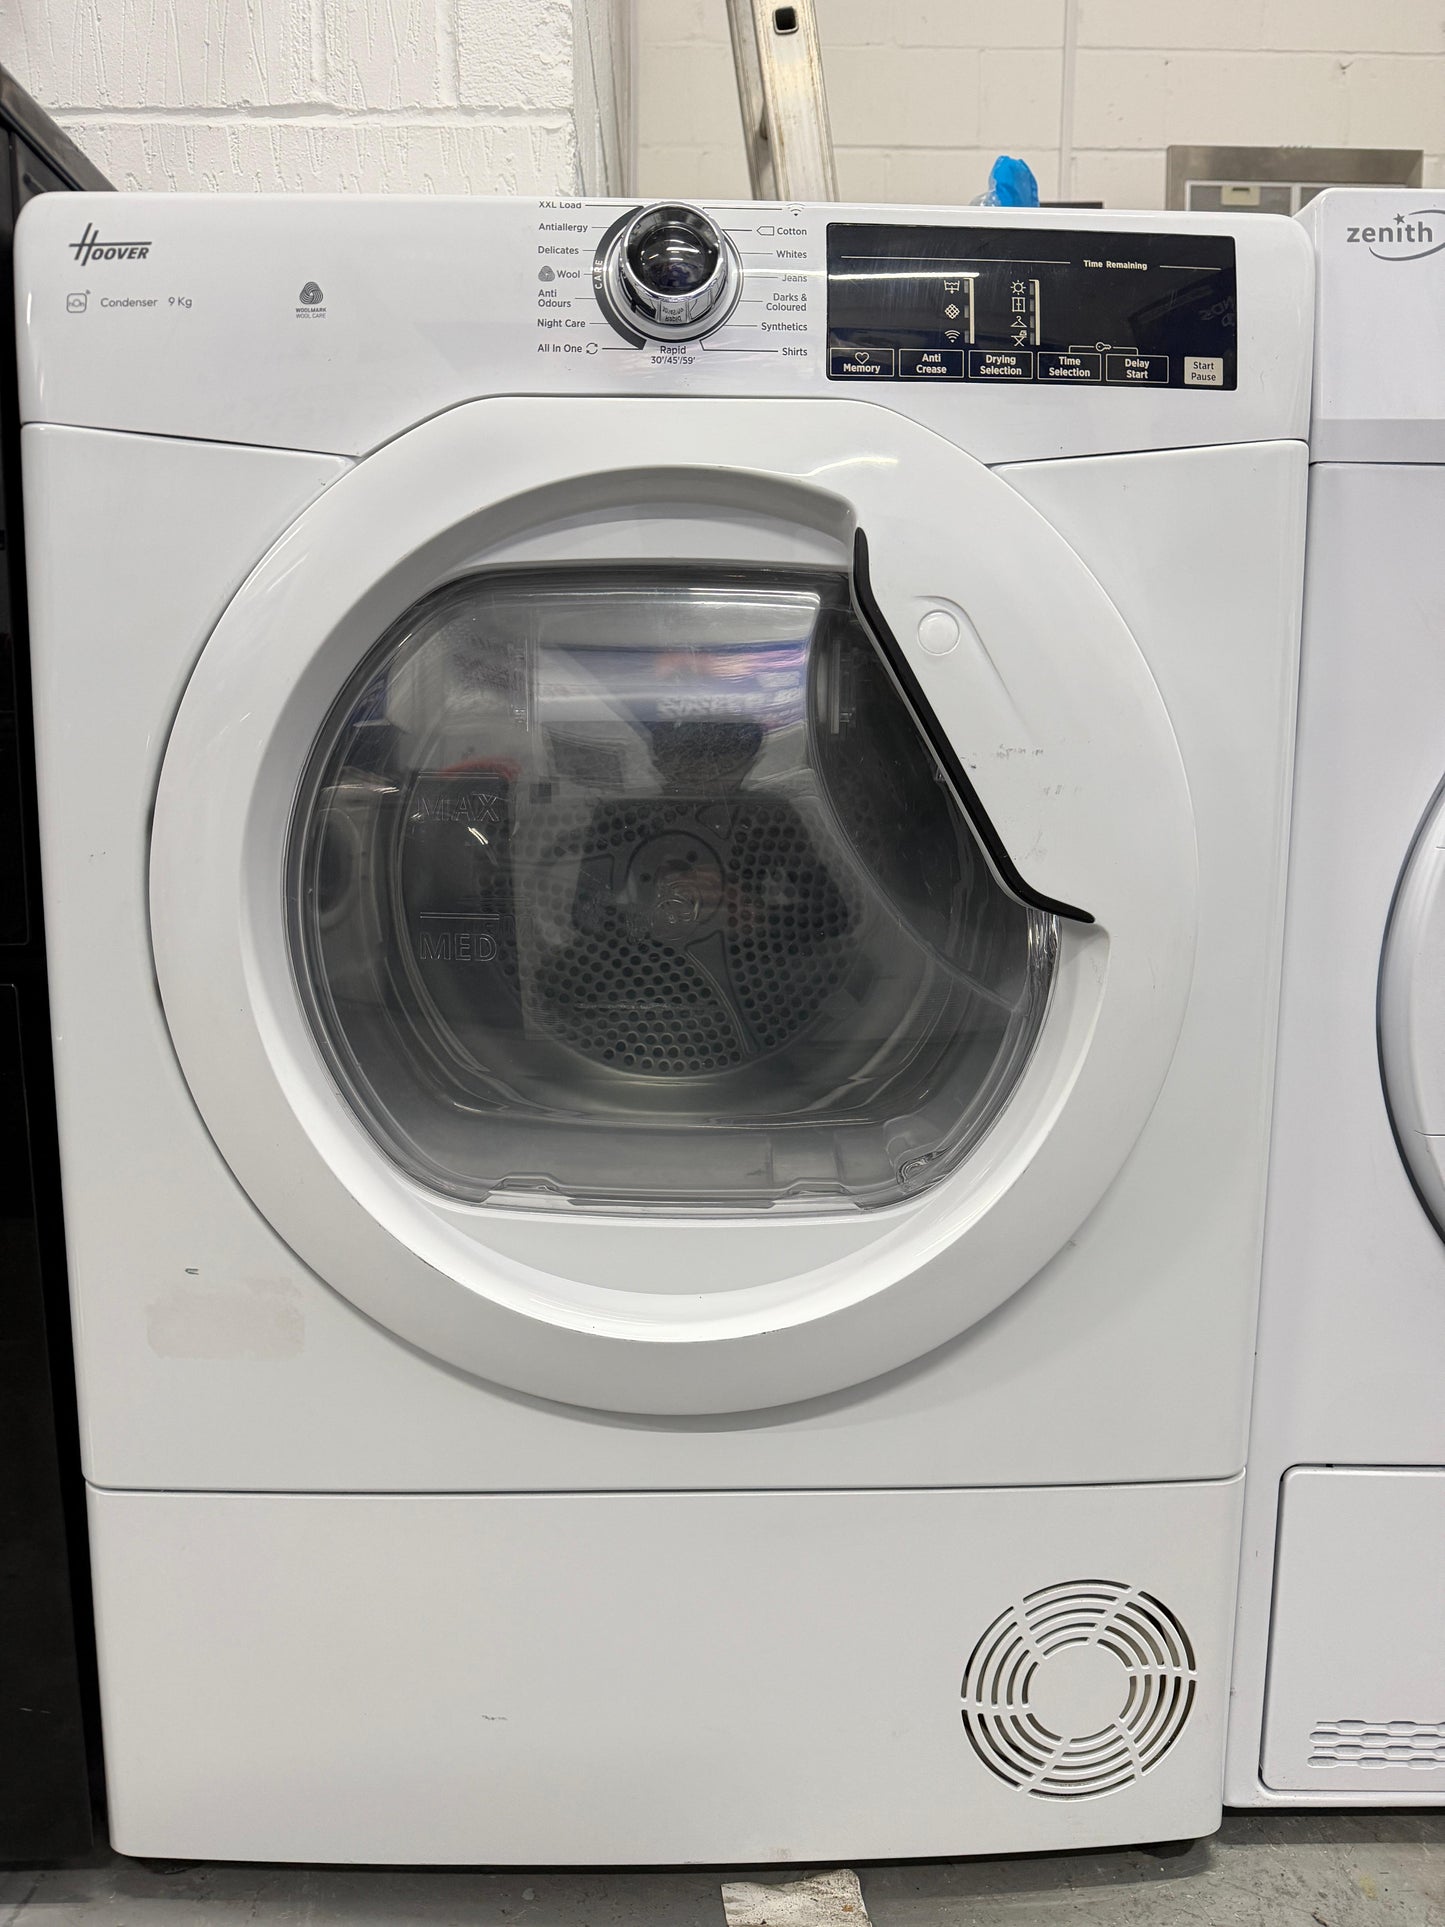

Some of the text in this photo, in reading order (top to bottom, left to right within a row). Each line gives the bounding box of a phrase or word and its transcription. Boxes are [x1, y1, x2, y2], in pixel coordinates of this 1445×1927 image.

[559, 201, 582, 209] Load
[538, 222, 588, 233] Antiallergy
[776, 227, 807, 236] Cotton
[1346, 213, 1433, 243] zenith
[537, 245, 580, 255] Delicates
[776, 249, 808, 259] Whites
[1083, 260, 1148, 271] Time Remaining
[557, 269, 581, 279] Wool
[593, 259, 604, 290] CARE
[781, 273, 808, 282] Jeans
[537, 289, 557, 298] Anti
[773, 292, 808, 301] Darks &
[99, 297, 158, 307] Condenser
[167, 296, 193, 309] 9 Kg
[537, 299, 572, 308] Odours
[766, 302, 807, 311] Coloured
[537, 318, 586, 329] Night Care
[761, 321, 808, 332] Synthetics
[537, 344, 583, 353] All In One
[660, 346, 687, 356] Rapid
[782, 347, 808, 356] Shirts
[921, 353, 942, 363] Anti
[985, 354, 1017, 365] Drying
[1058, 356, 1081, 366] Time
[843, 363, 881, 374] Memory
[1124, 358, 1150, 369] Delay
[1192, 361, 1215, 371] Start
[915, 364, 948, 374] Crease
[979, 365, 1022, 376] Selection
[1049, 367, 1091, 378] Selection
[1126, 369, 1149, 379] Start
[1191, 372, 1217, 382] Pause
[417, 793, 500, 822] MAX
[419, 931, 498, 962] MED
